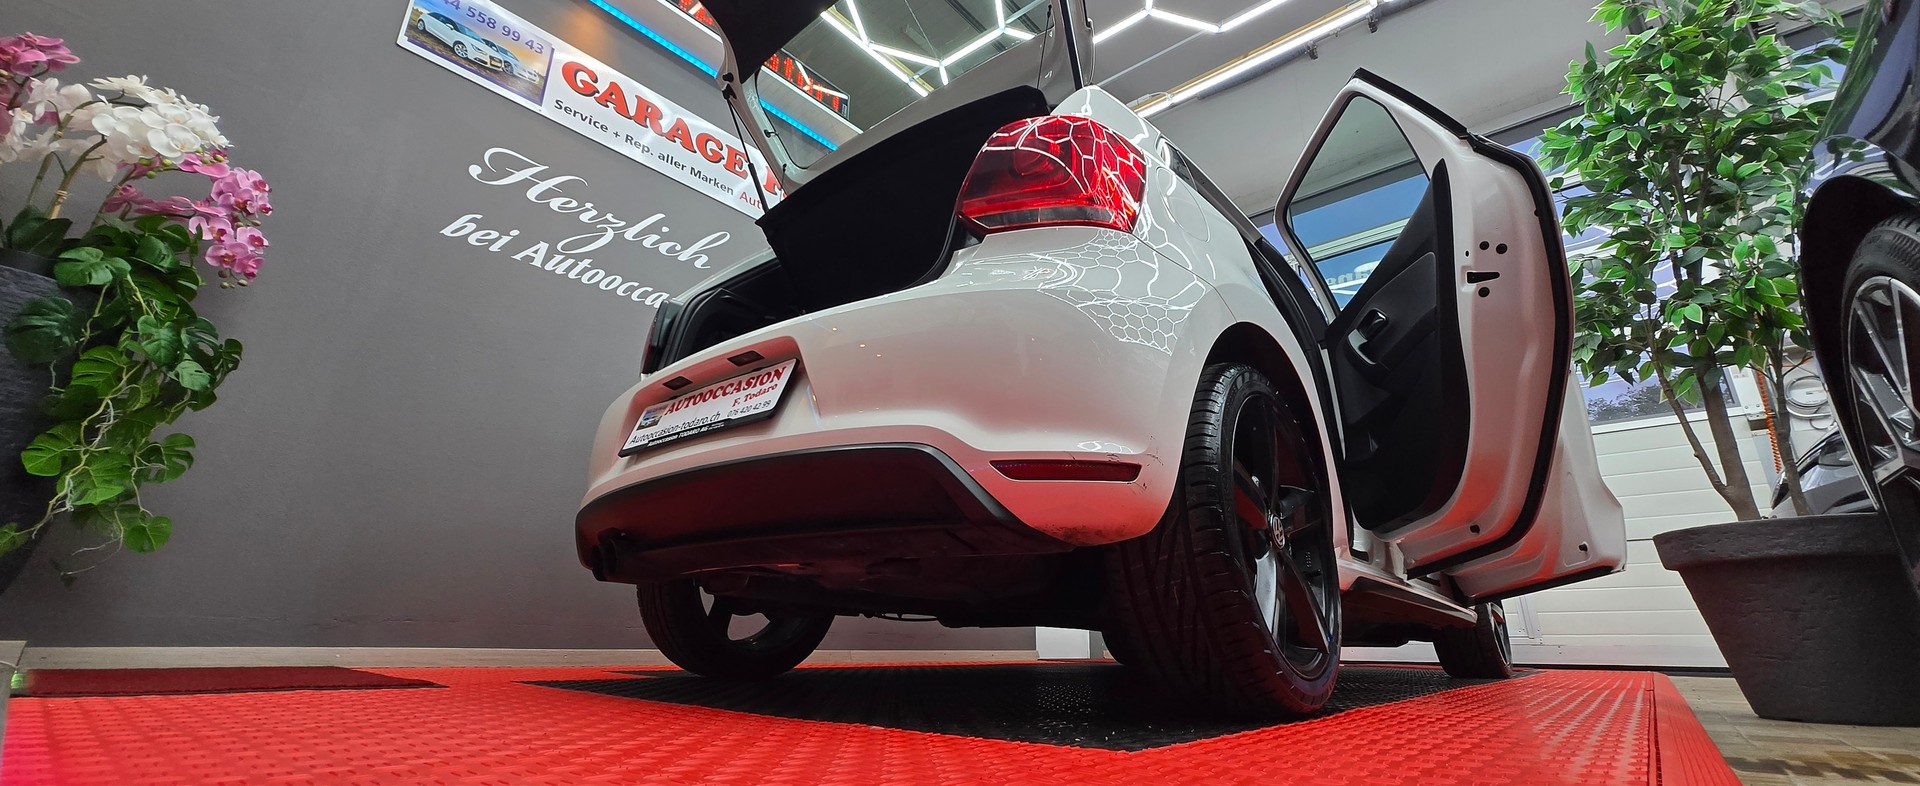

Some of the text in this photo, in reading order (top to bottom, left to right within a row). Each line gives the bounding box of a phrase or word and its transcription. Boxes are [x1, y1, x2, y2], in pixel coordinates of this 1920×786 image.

[466, 5, 496, 30] 558
[502, 25, 521, 42] 99
[525, 38, 544, 55] 43
[561, 61, 749, 180] GARAGE
[554, 99, 608, 133] Service
[613, 130, 621, 138] +
[625, 133, 653, 156] Rep.
[657, 150, 687, 172] aller
[689, 166, 734, 195] Marken
[439, 214, 520, 251] bei
[468, 147, 730, 269] Herzlich
[664, 366, 787, 415] AUTOOCCASION
[732, 384, 778, 407] F. Todaro
[630, 411, 721, 444] Autooccasion-todaro.ch
